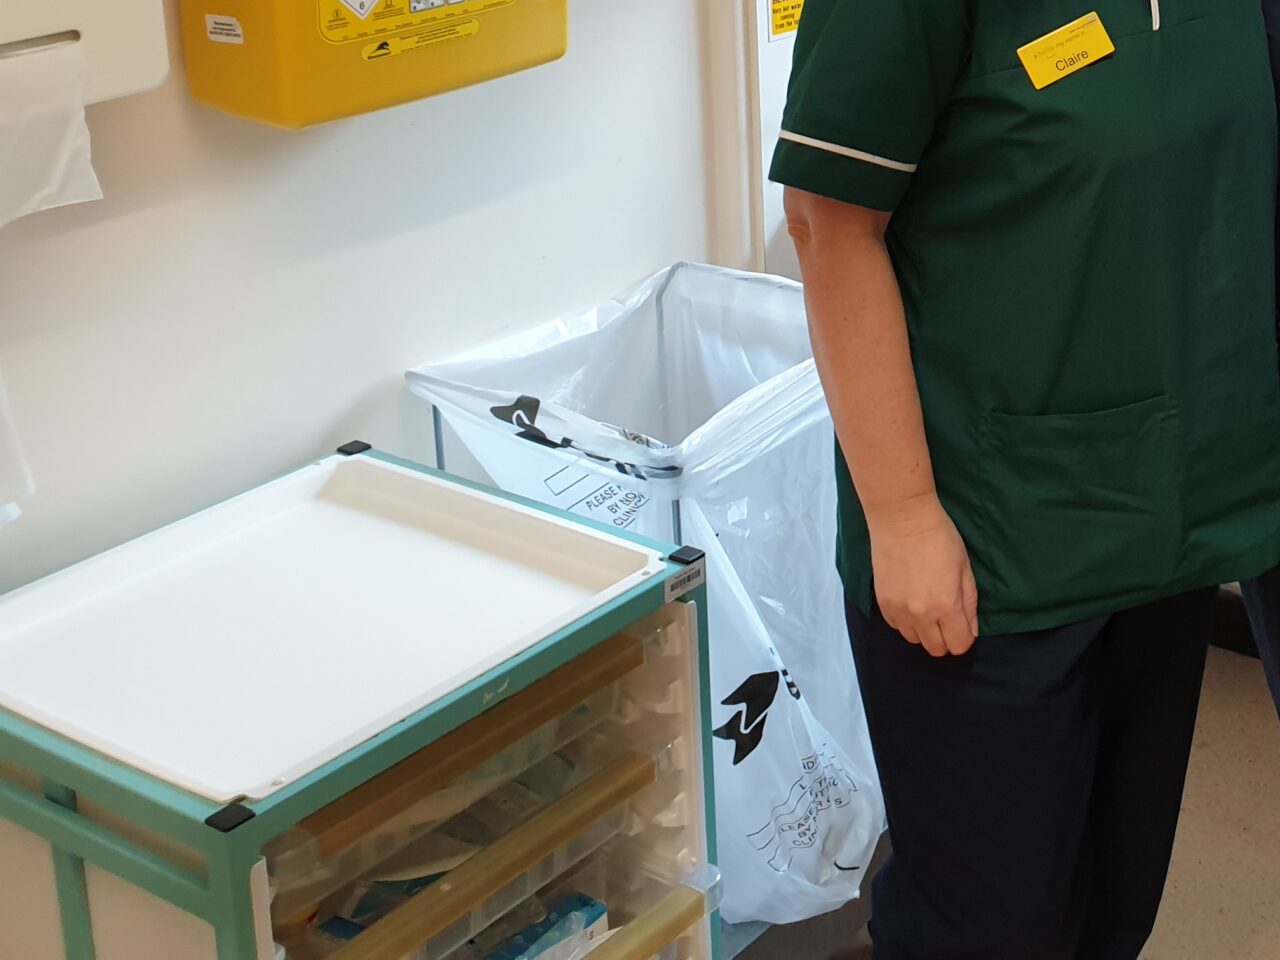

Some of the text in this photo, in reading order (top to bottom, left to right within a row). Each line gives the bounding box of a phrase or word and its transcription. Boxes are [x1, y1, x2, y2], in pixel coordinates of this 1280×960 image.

[359, 1, 366, 10] 6
[1055, 50, 1089, 71] Claire
[585, 485, 618, 511] PLEASE
[606, 501, 622, 514] BY
